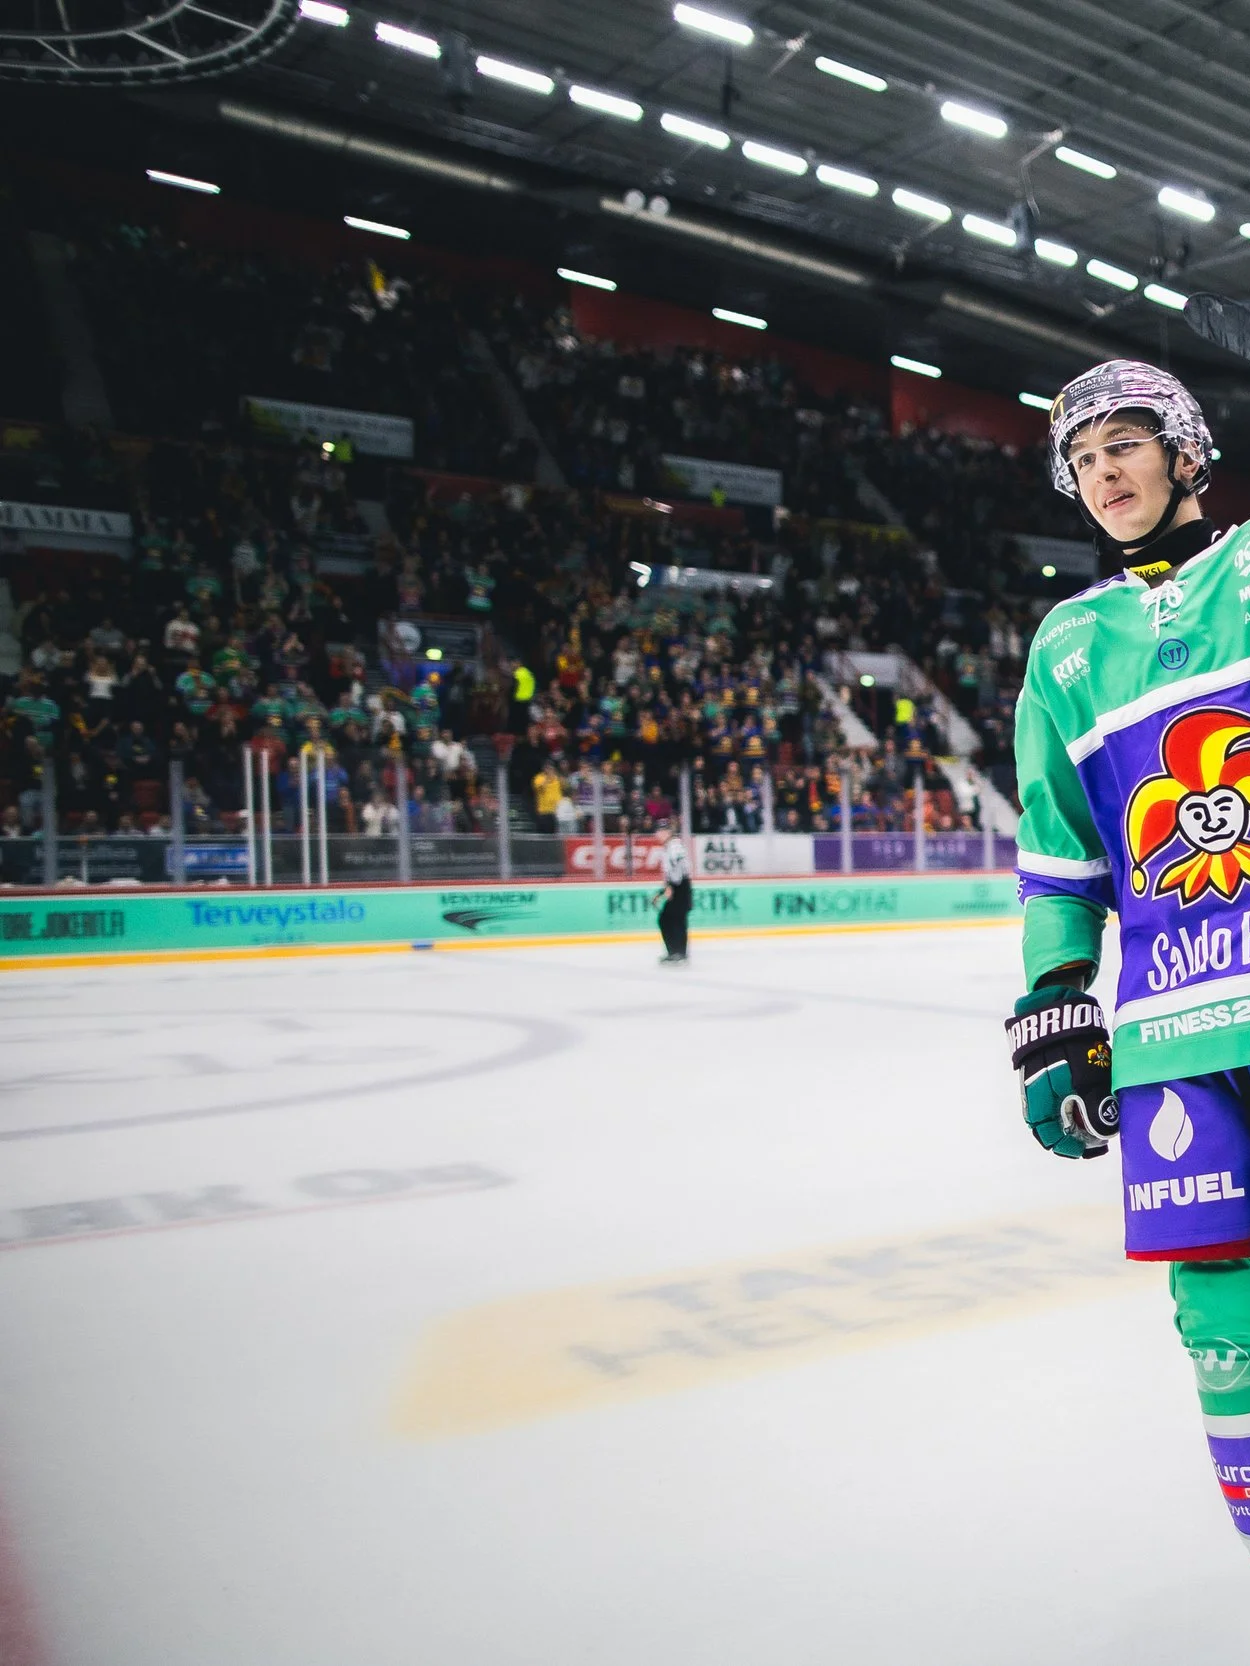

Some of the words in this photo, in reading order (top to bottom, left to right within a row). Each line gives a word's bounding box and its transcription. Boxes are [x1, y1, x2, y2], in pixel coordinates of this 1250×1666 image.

[1069, 374, 1114, 394] CREATIVE
[1071, 380, 1115, 398] TECHNOLOGY
[1053, 648, 1089, 685] RTK
[704, 841, 737, 854] ALL
[186, 898, 366, 928] Terveystalo
[1148, 919, 1232, 992] Saldo
[1129, 1171, 1246, 1213] INFUEL
